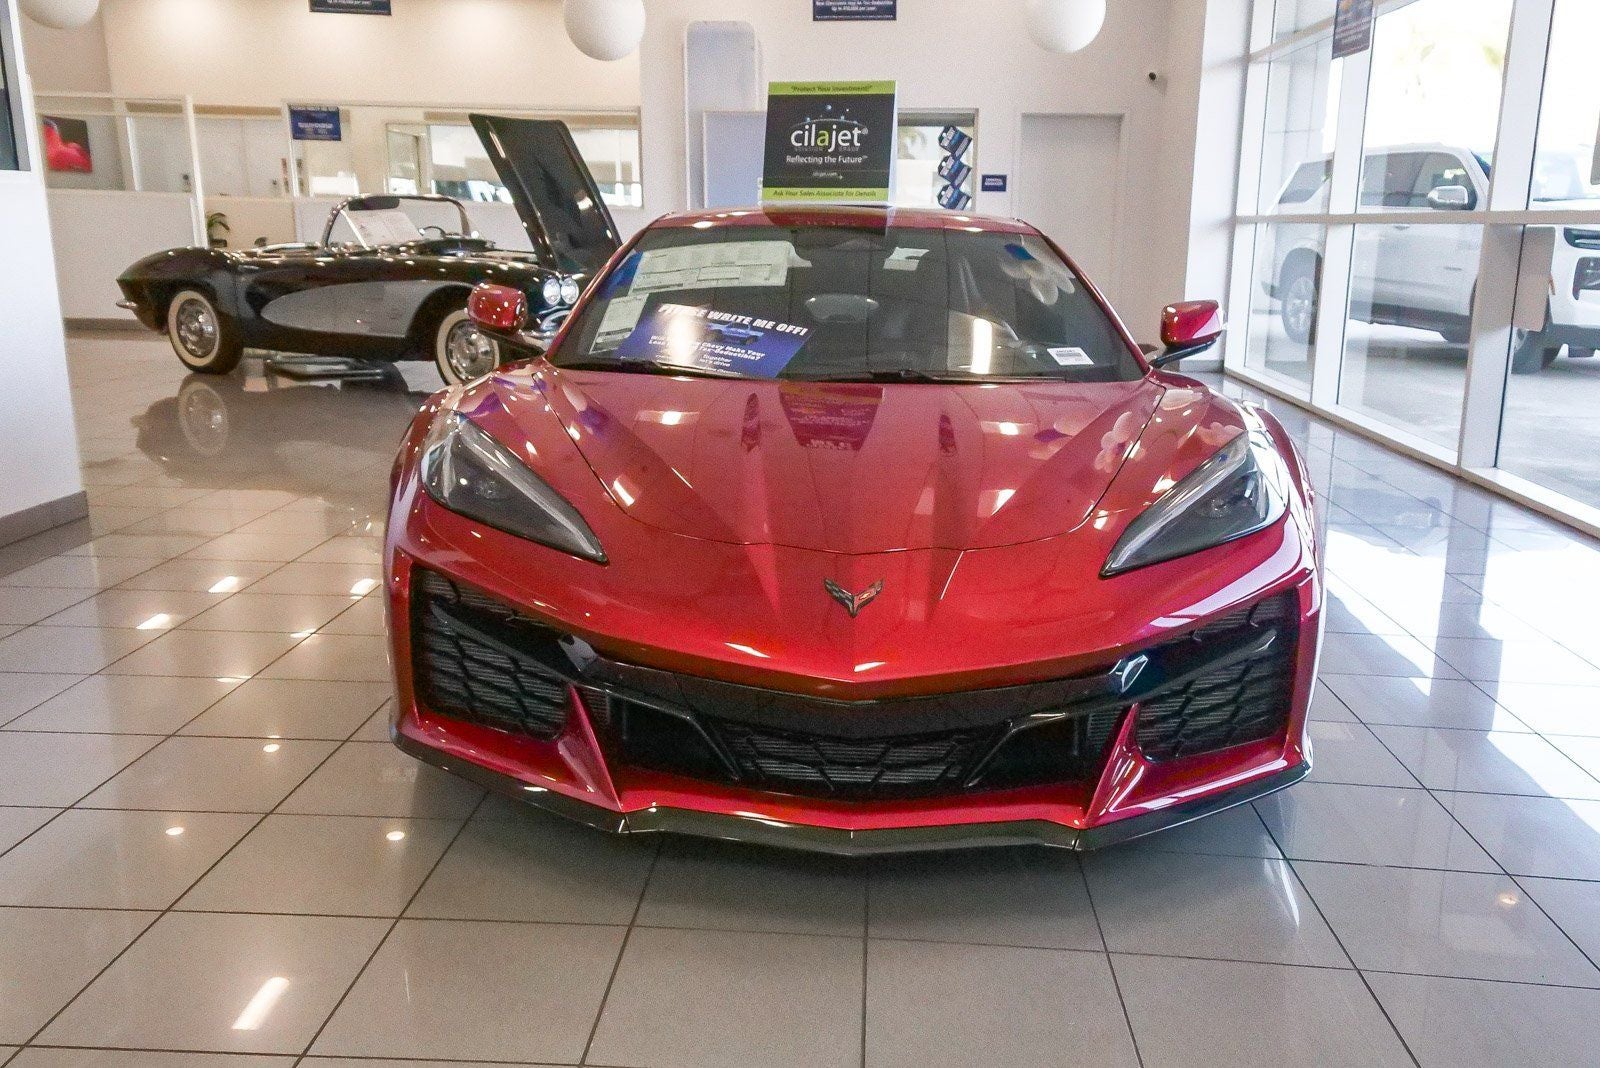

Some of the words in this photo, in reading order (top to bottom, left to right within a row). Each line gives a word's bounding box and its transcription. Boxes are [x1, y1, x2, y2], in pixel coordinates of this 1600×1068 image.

[786, 155, 823, 164] Reflecting
[824, 155, 837, 163] the
[707, 310, 753, 326] WRITE
[752, 318, 776, 330] ME
[775, 323, 809, 336] OFF!
[701, 341, 725, 351] Chevy
[725, 345, 746, 354] Make
[747, 350, 766, 358] Your
